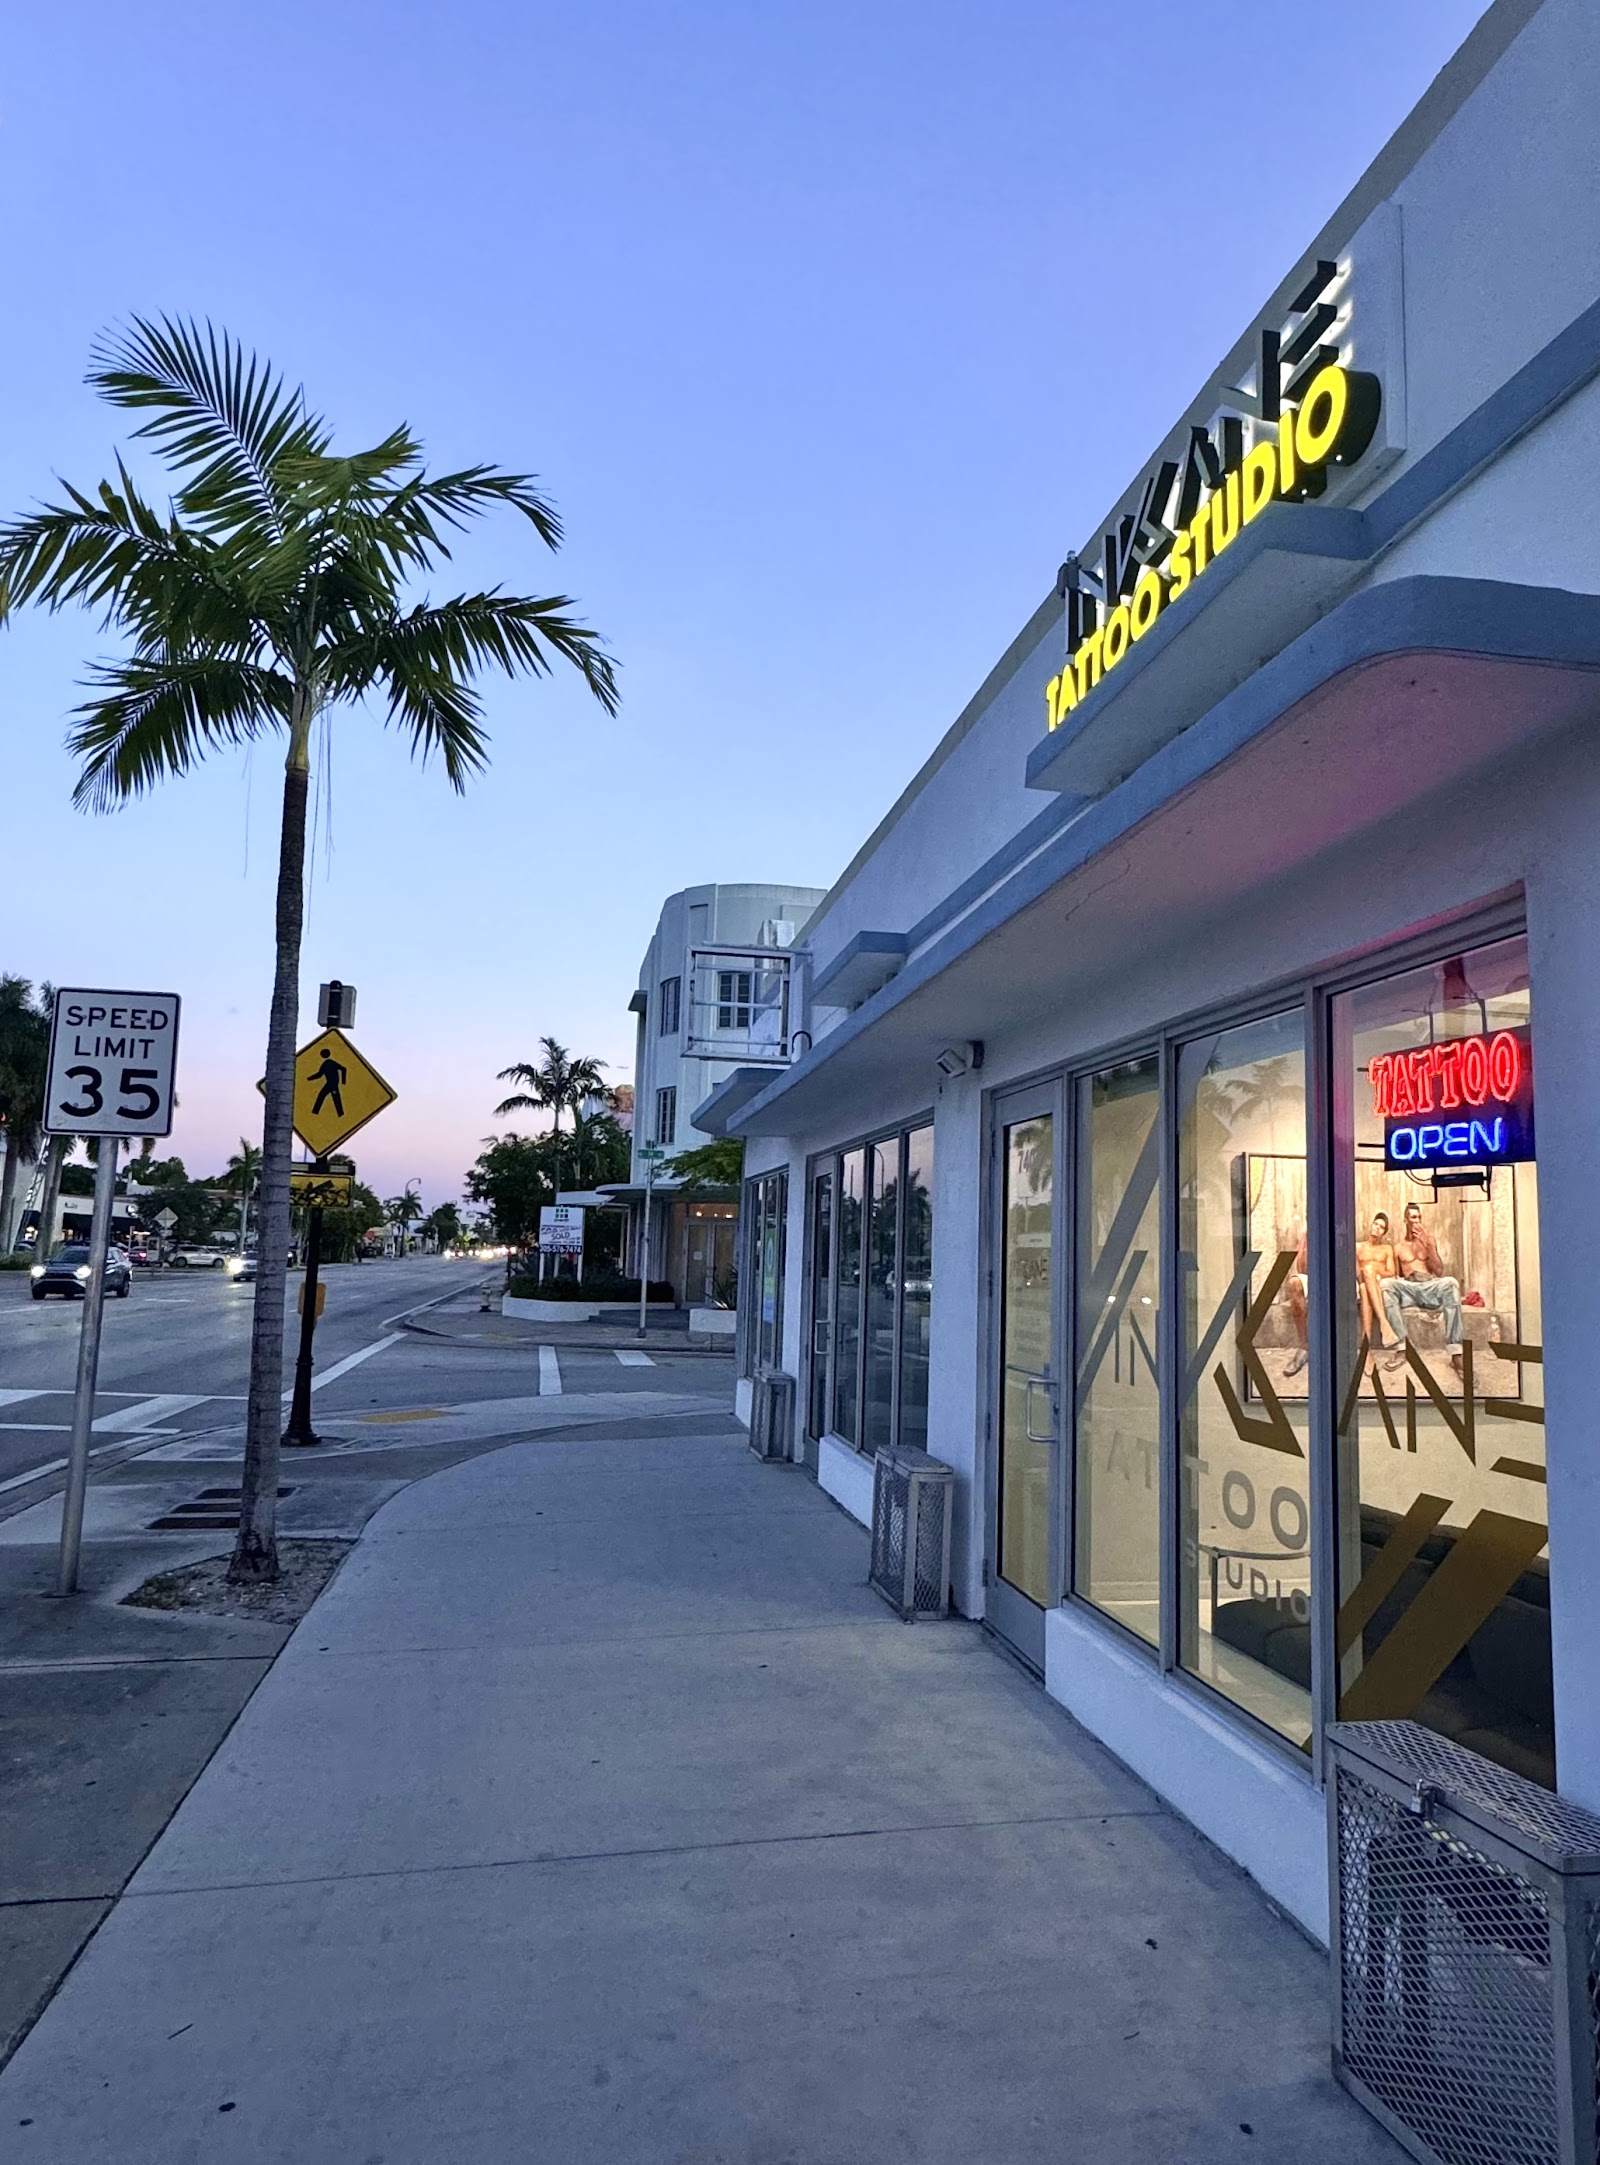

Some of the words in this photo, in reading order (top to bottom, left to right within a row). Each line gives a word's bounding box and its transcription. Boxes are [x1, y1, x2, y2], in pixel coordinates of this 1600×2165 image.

[1045, 574, 1161, 733] TATTOO
[1168, 366, 1347, 603] STUDIO
[66, 1005, 168, 1031] SPEED
[75, 1035, 154, 1060] LIMIT
[59, 1065, 160, 1120] 35
[1367, 1032, 1520, 1118] TATTOO
[1389, 1117, 1503, 1161] OPEN
